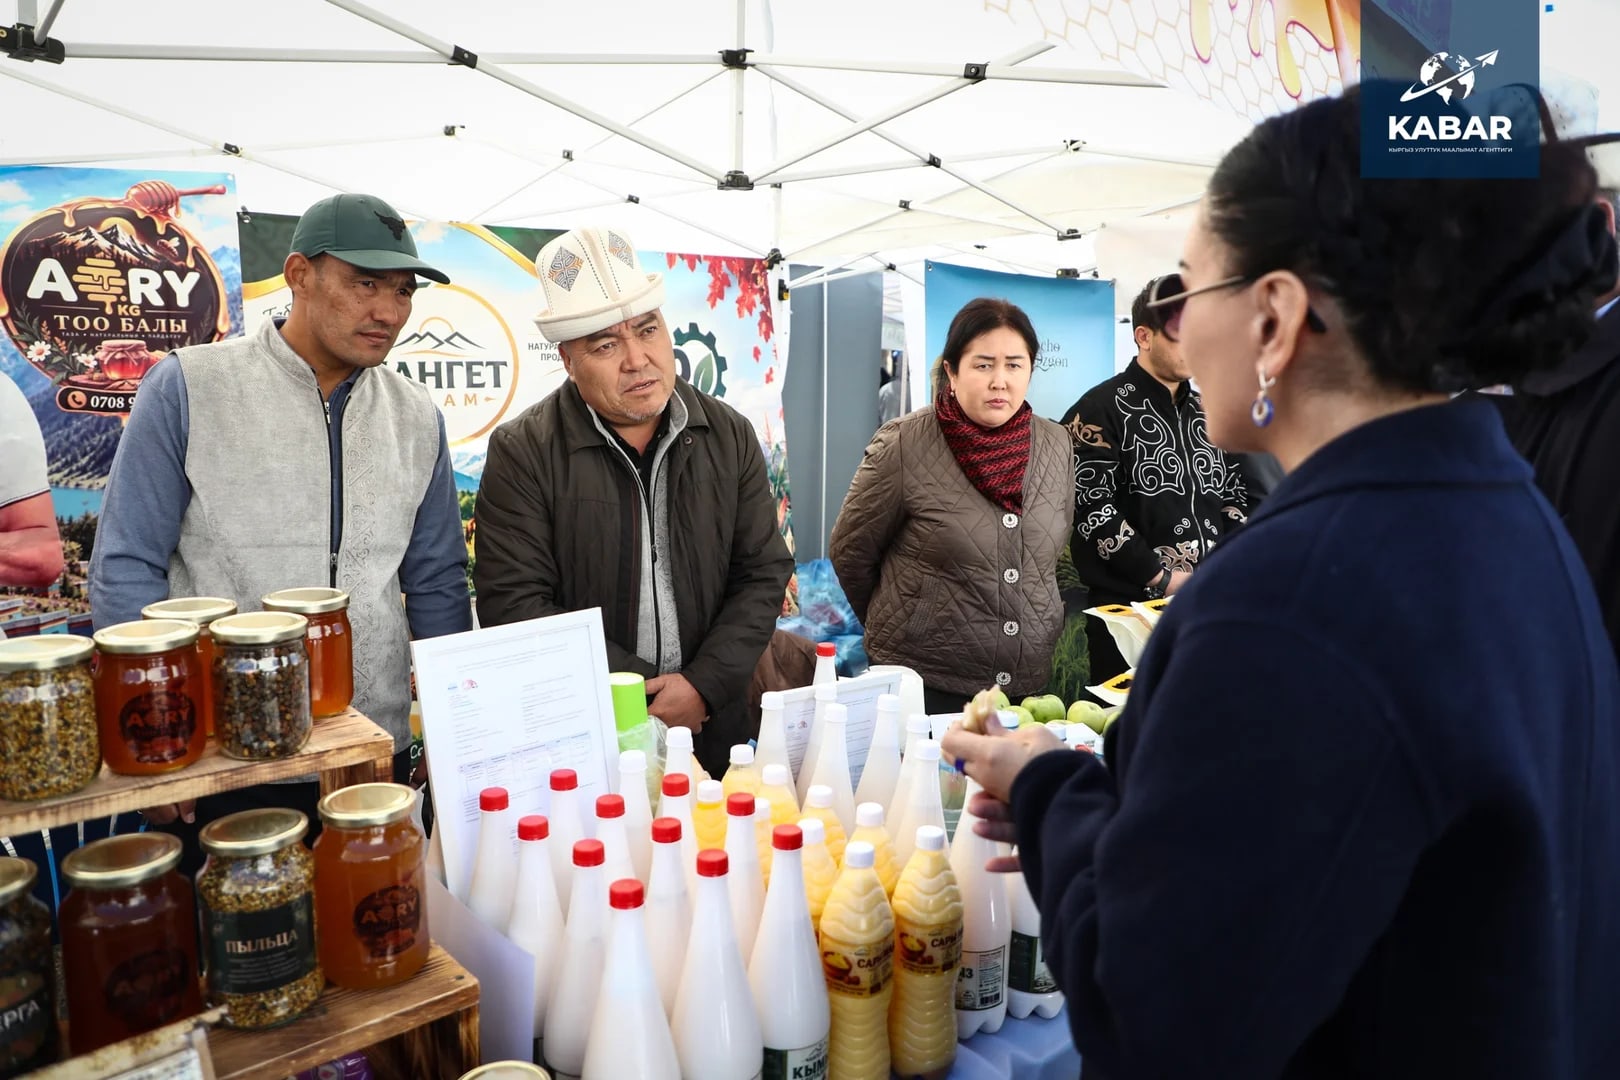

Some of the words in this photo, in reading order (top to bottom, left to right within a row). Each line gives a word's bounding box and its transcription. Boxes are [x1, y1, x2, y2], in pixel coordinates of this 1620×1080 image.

[53, 314, 110, 332] ТОО
[120, 317, 188, 333] БАЛЫ
[380, 360, 508, 389] АНГЕТ
[90, 395, 125, 409] 0708
[225, 929, 298, 953] ПЫЛЬЦА
